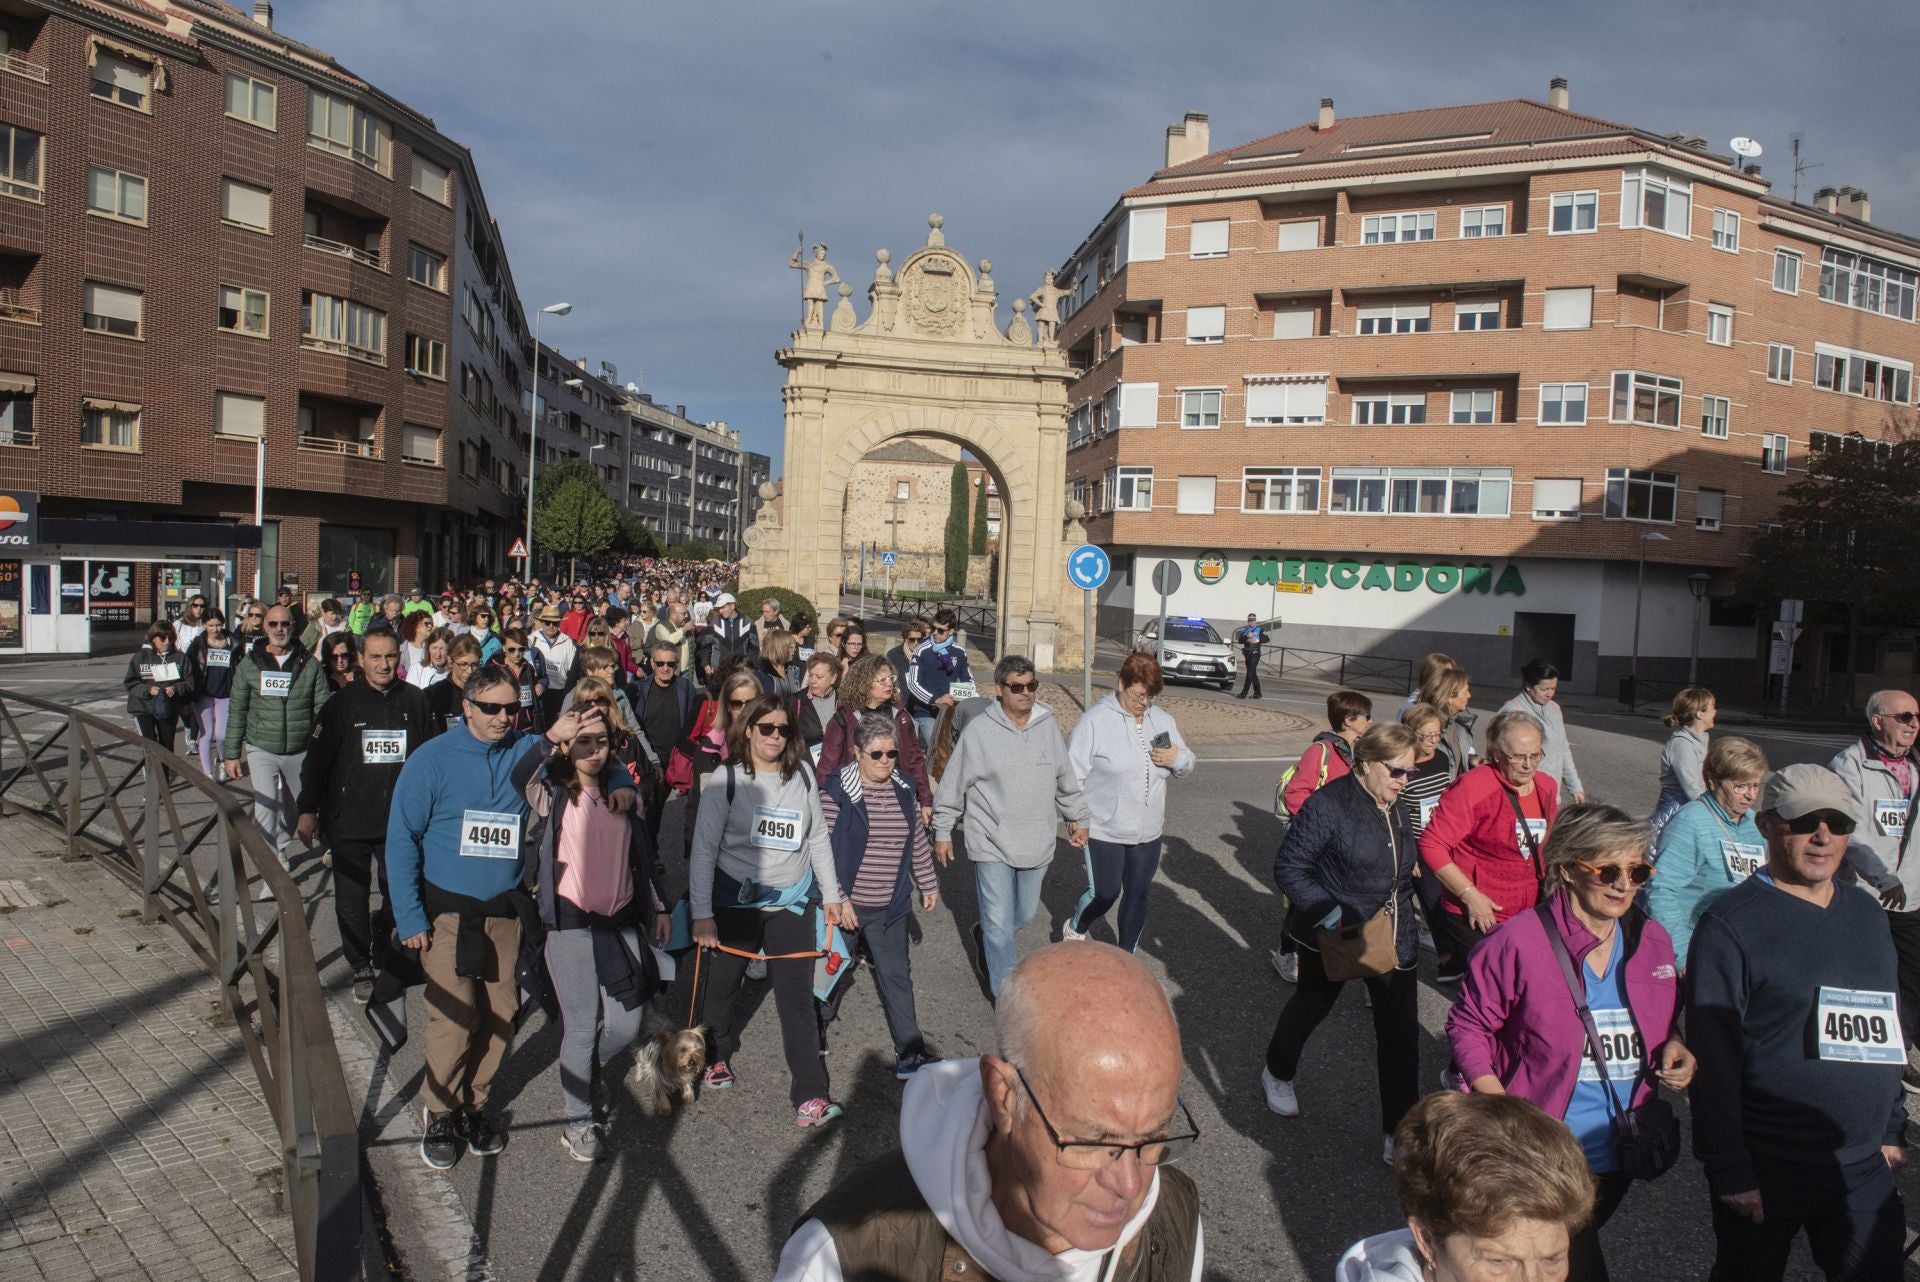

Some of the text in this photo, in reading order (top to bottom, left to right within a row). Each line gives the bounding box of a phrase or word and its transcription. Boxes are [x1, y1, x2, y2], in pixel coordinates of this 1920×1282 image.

[1246, 555, 1526, 596] MERCADONA
[265, 679, 291, 689] 6622
[952, 689, 972, 698] 5855
[365, 741, 400, 754] 4555
[468, 826, 511, 846] 4949
[757, 819, 795, 839] 4950
[1824, 1012, 1888, 1044] 4609
[1583, 1032, 1643, 1062] 4608
